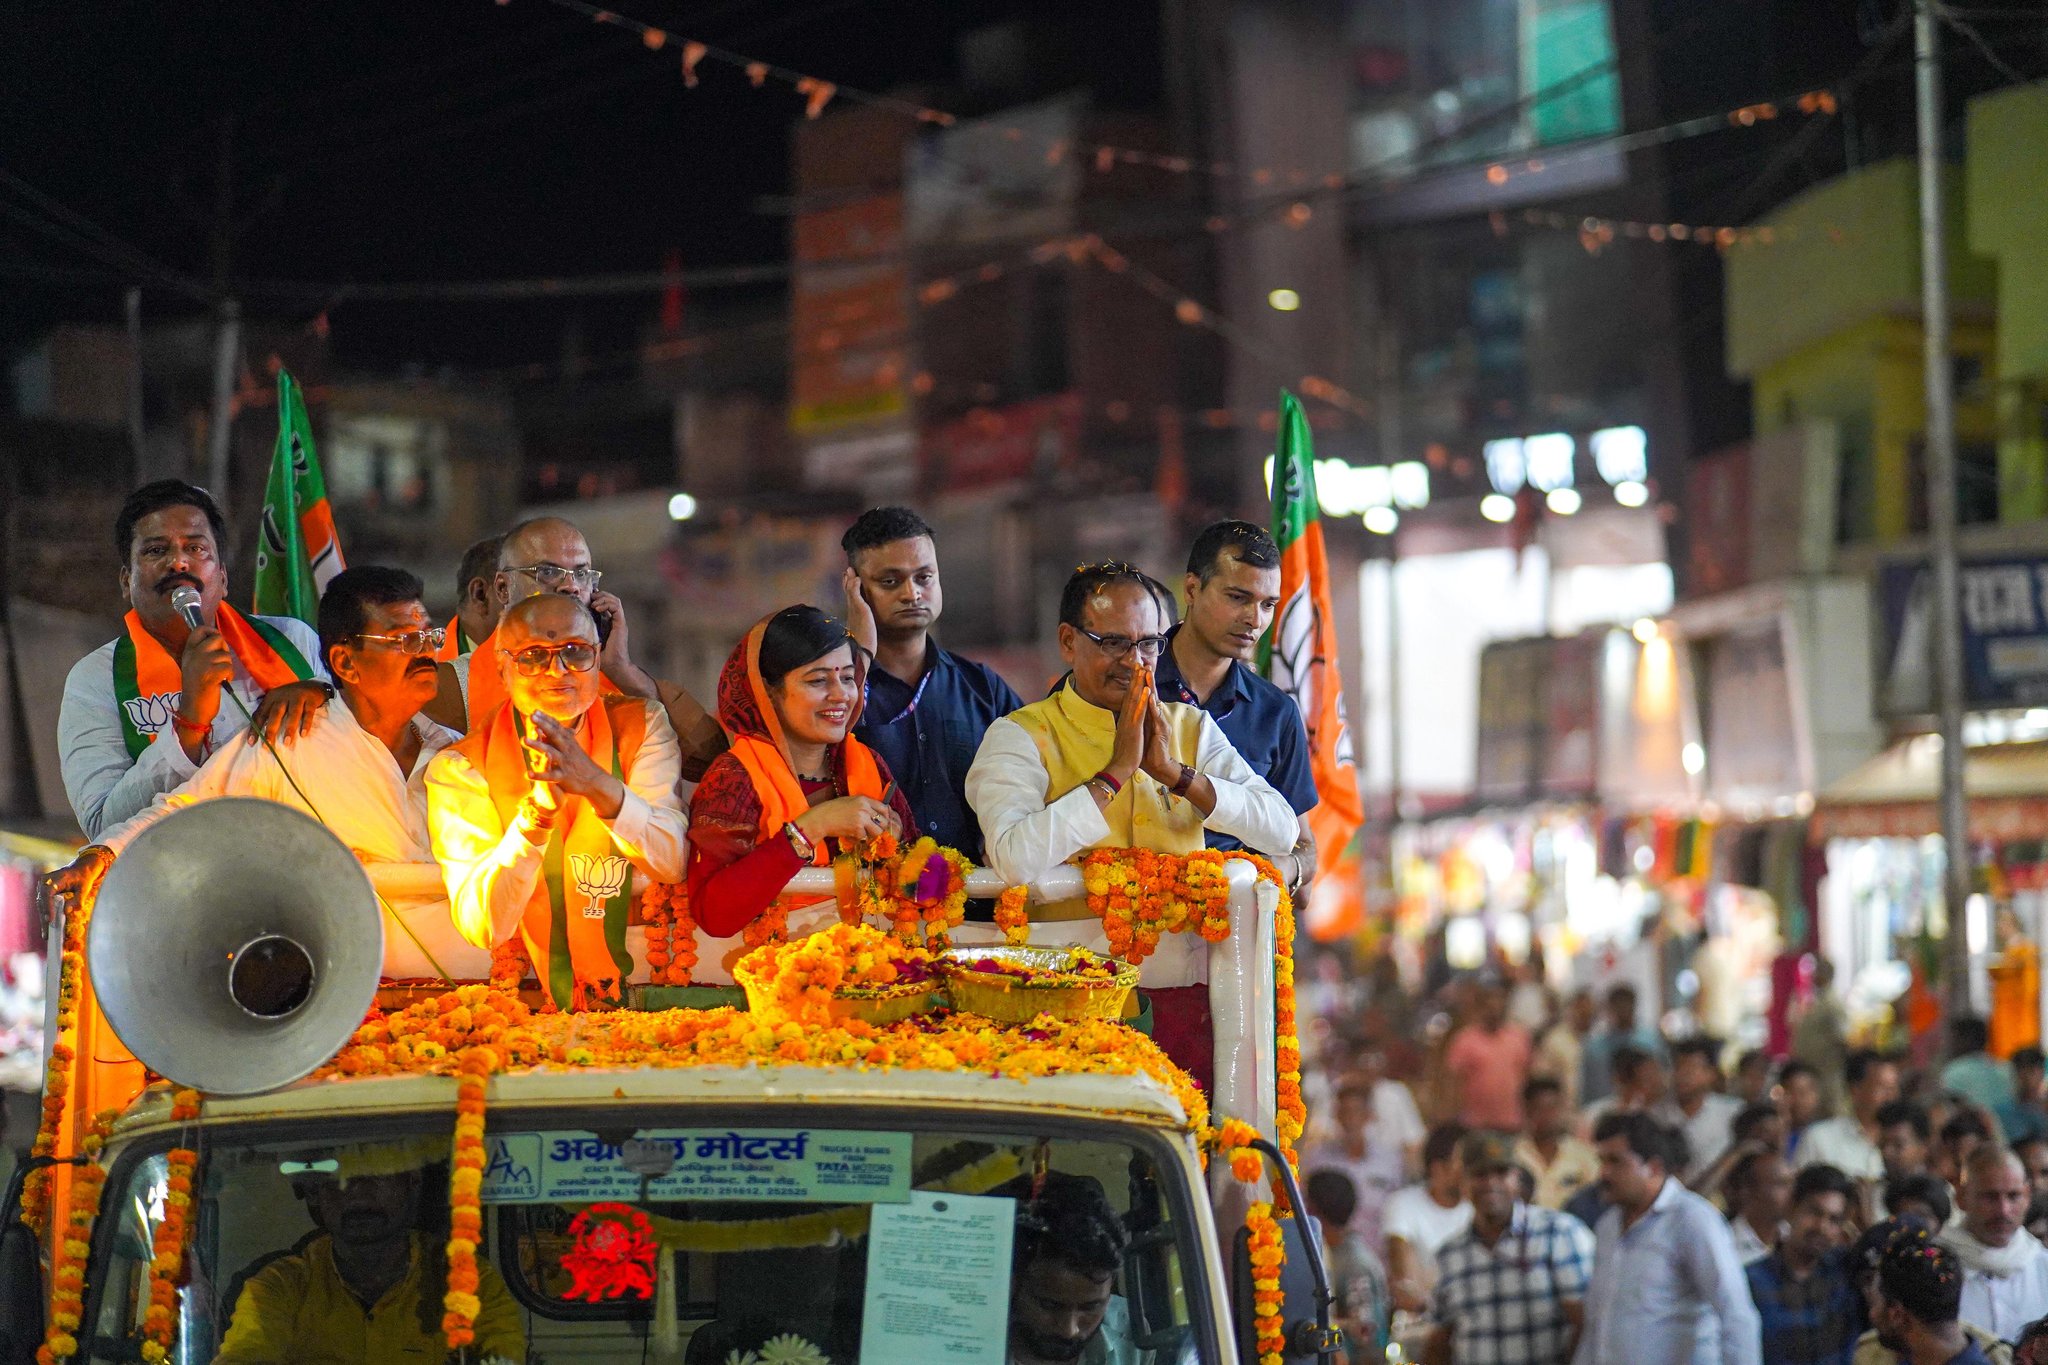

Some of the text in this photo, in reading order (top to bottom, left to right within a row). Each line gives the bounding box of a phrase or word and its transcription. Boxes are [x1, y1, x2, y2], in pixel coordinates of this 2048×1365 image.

[695, 1131, 811, 1160] मोटर्स
[820, 1145, 852, 1153] TRUCKS
[863, 1146, 890, 1154] BUSES
[815, 1162, 894, 1173] TATA MOTORS
